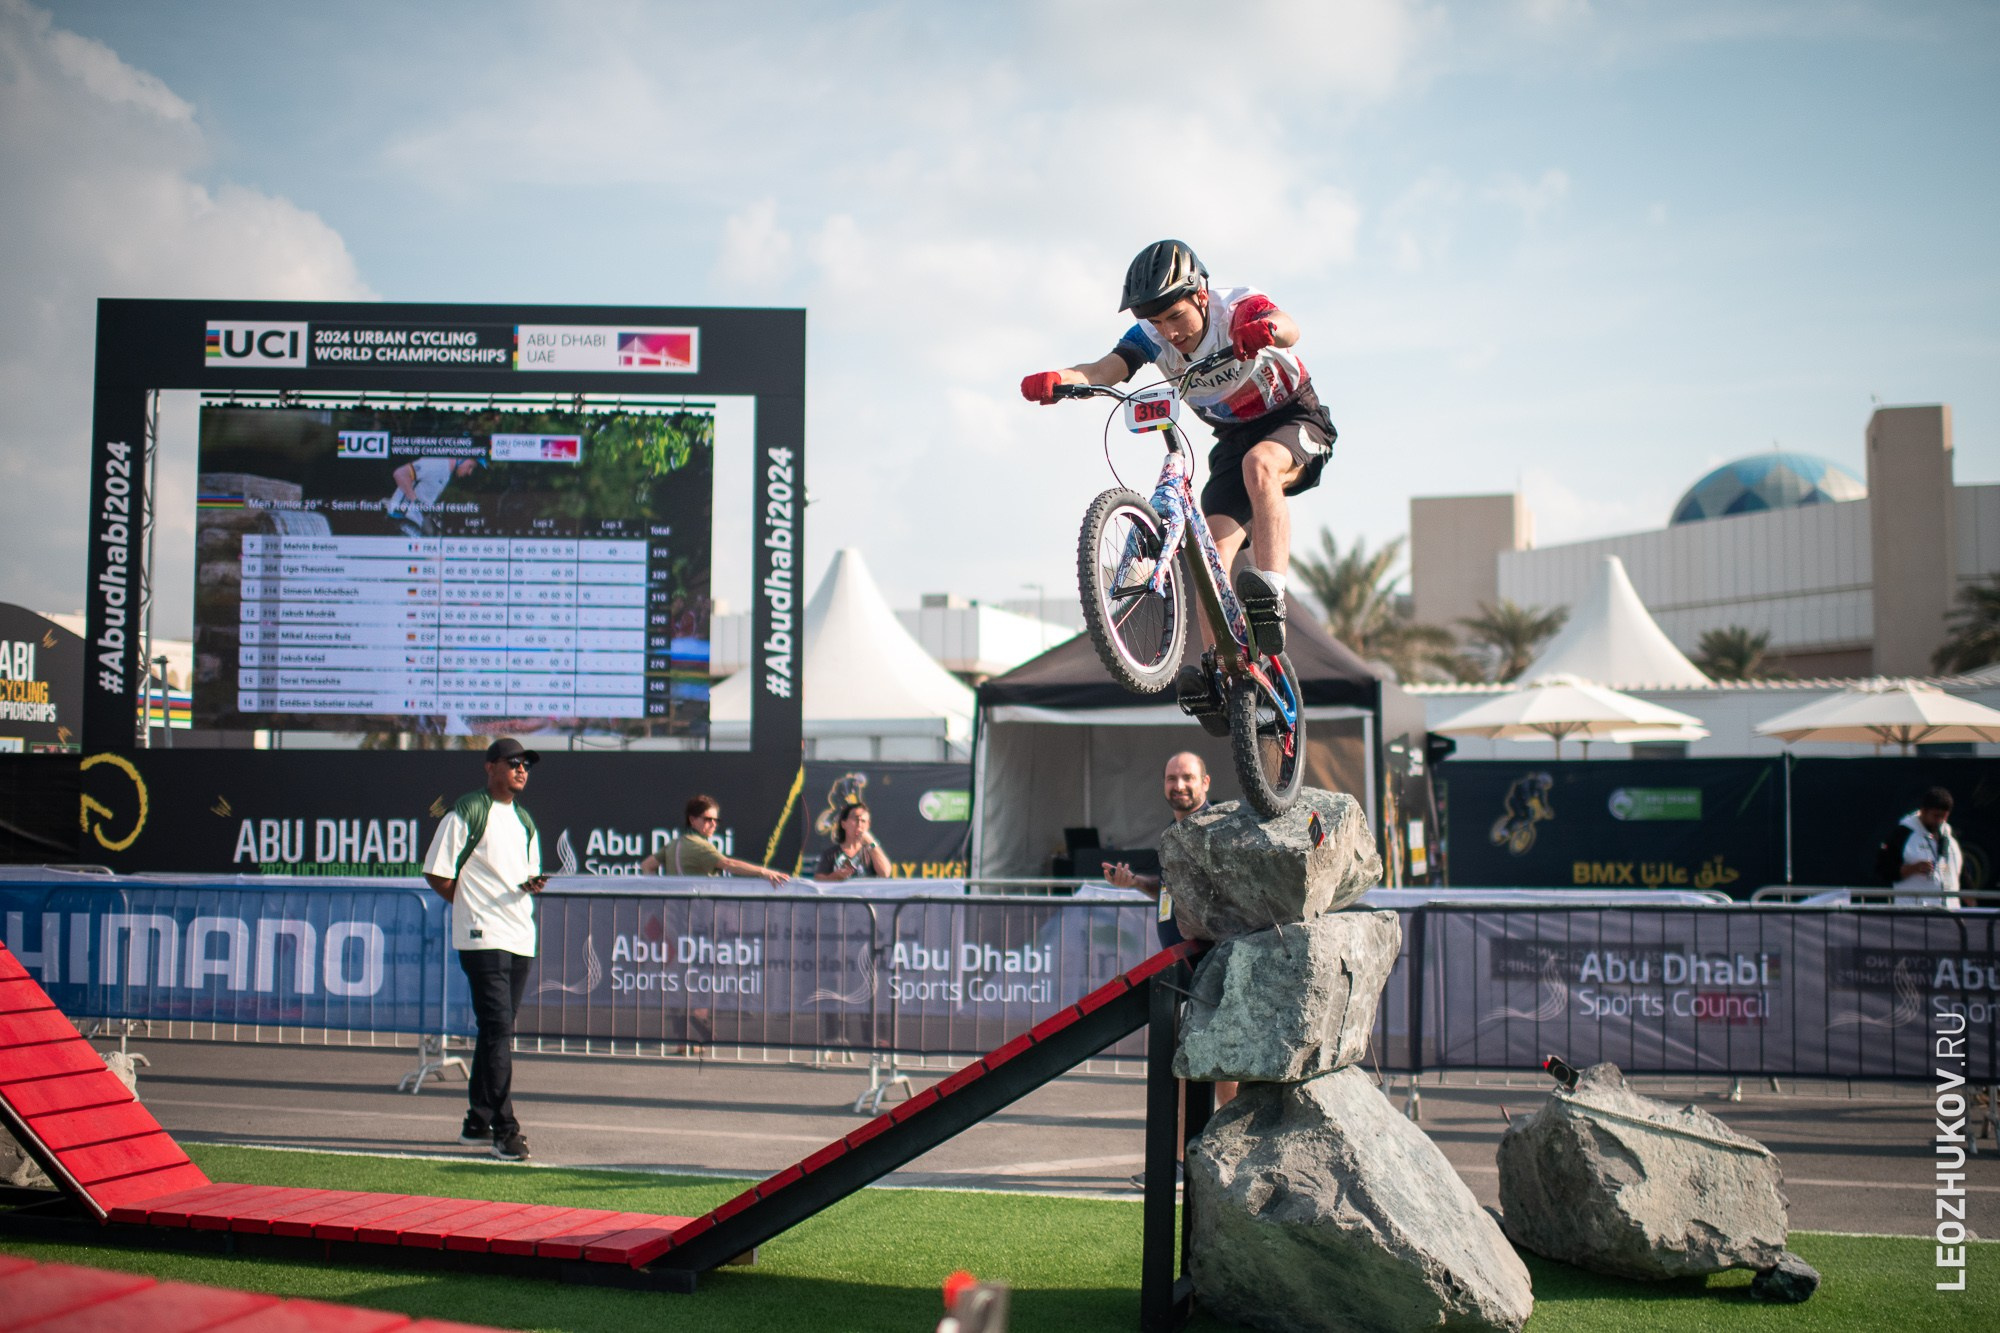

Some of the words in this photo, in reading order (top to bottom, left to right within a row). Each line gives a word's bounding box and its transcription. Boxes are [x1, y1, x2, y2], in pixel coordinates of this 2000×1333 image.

[223, 330, 299, 360] UCI
[315, 331, 350, 345] 2024
[353, 331, 404, 346] URBAN
[409, 332, 477, 347] CYCLING
[526, 334, 558, 348] ABU
[561, 334, 606, 348] DHABI
[315, 346, 371, 361] WORLD
[374, 347, 507, 364] CHAMPIONSHIPS
[527, 349, 556, 364] UAE
[1139, 401, 1167, 421] 316
[346, 437, 384, 454] UCI
[391, 447, 420, 456] WORLD
[421, 447, 488, 457] CHAMPIONSHIPS
[445, 502, 479, 513] results
[650, 526, 670, 536] Total
[98, 440, 132, 695] #Abudhabi2024
[764, 447, 793, 698] #Abudhabi2024
[232, 818, 304, 864] ABU
[315, 818, 417, 864] DHABI
[586, 829, 643, 857] Abu
[1573, 862, 1634, 885] BMX
[611, 935, 668, 963] Abu
[677, 935, 760, 966] Dhabi
[888, 941, 949, 971] Abu
[962, 943, 1051, 974] Dhabi
[611, 966, 679, 995] Sports
[684, 968, 761, 994] Council
[1580, 953, 1650, 984] Abu
[1664, 953, 1770, 986] Dhabi
[888, 976, 962, 1005] Sports
[967, 977, 1052, 1004] Council
[1578, 989, 1664, 1020] Sports
[1673, 990, 1770, 1018] Council
